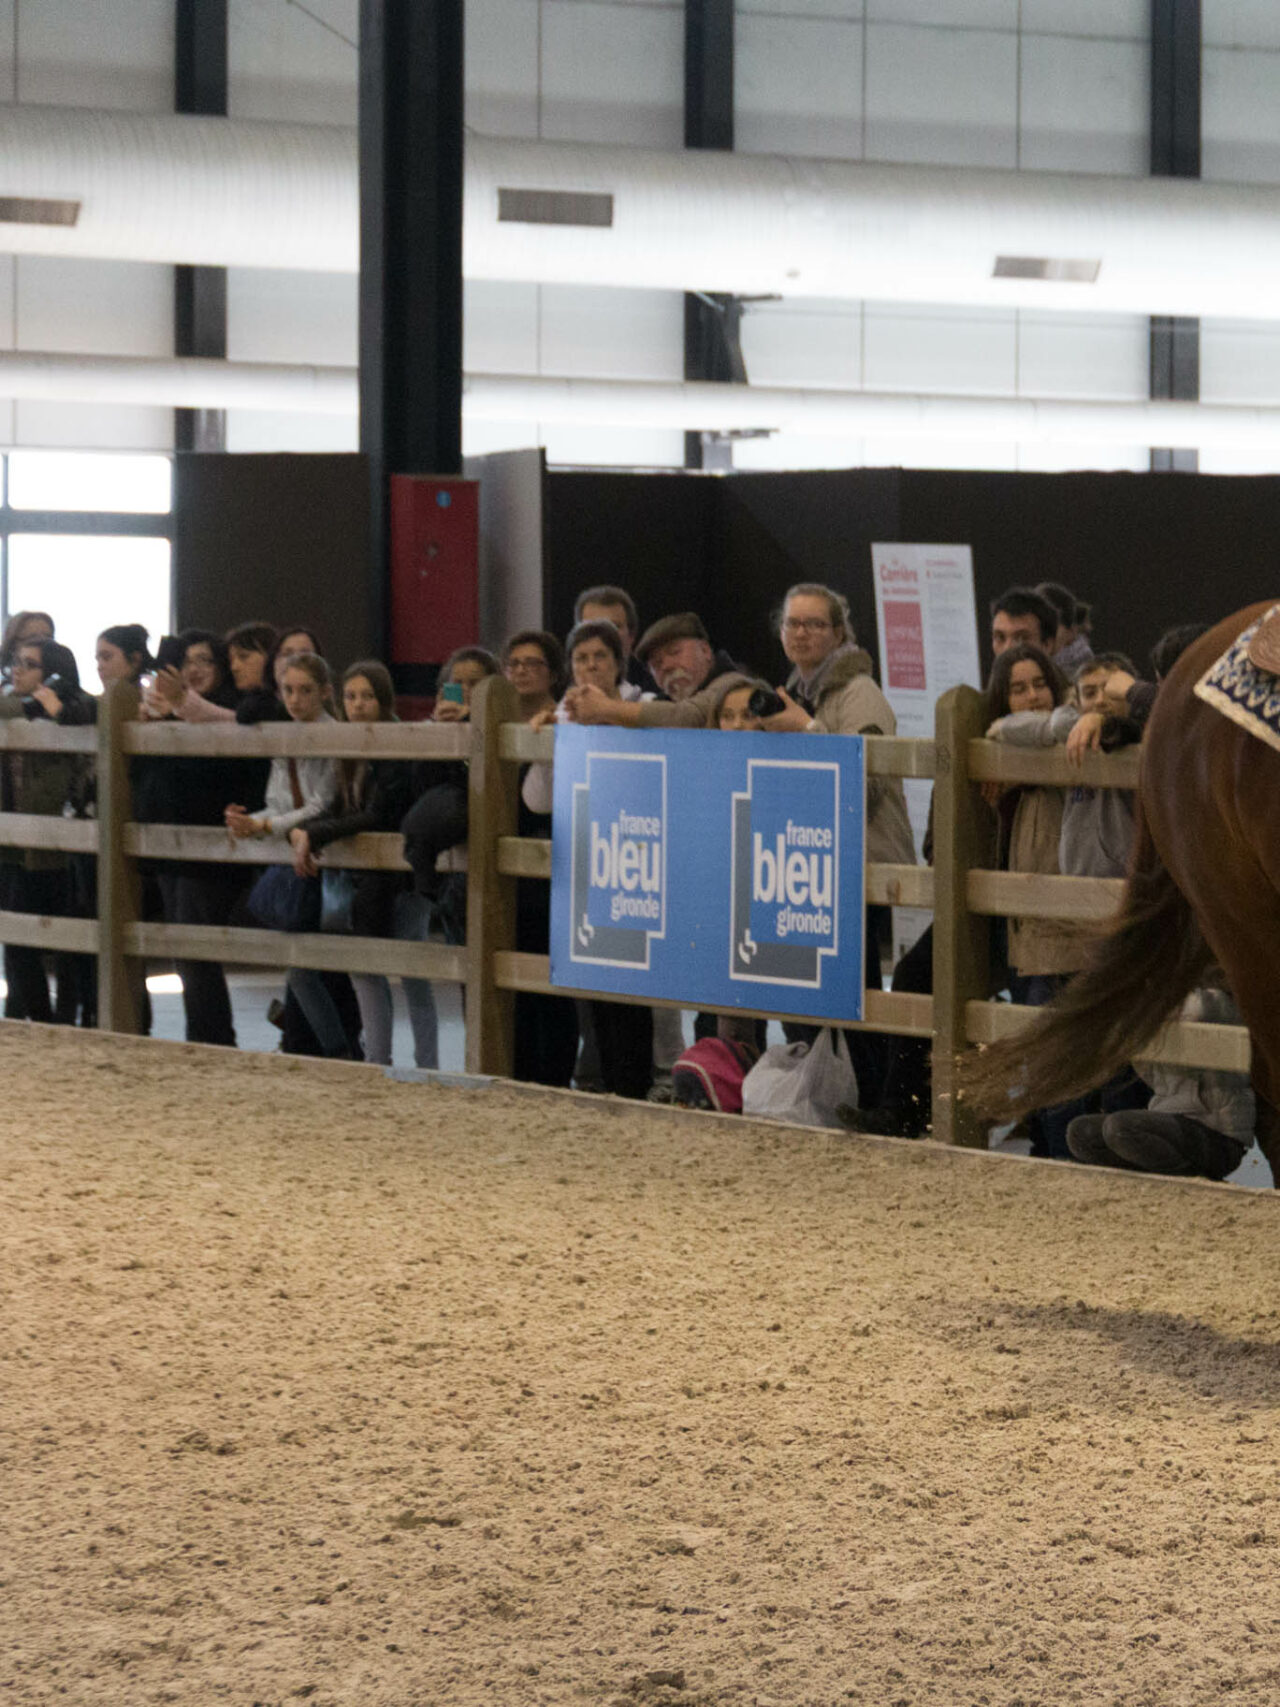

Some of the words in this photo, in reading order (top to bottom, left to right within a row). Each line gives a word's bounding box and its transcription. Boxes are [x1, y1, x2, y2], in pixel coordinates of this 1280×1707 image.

[619, 810, 661, 837] france
[786, 820, 832, 848] france
[590, 821, 660, 893] bleu
[753, 832, 832, 908] bleu
[611, 893, 660, 921] gironde
[776, 908, 832, 937] gironde
